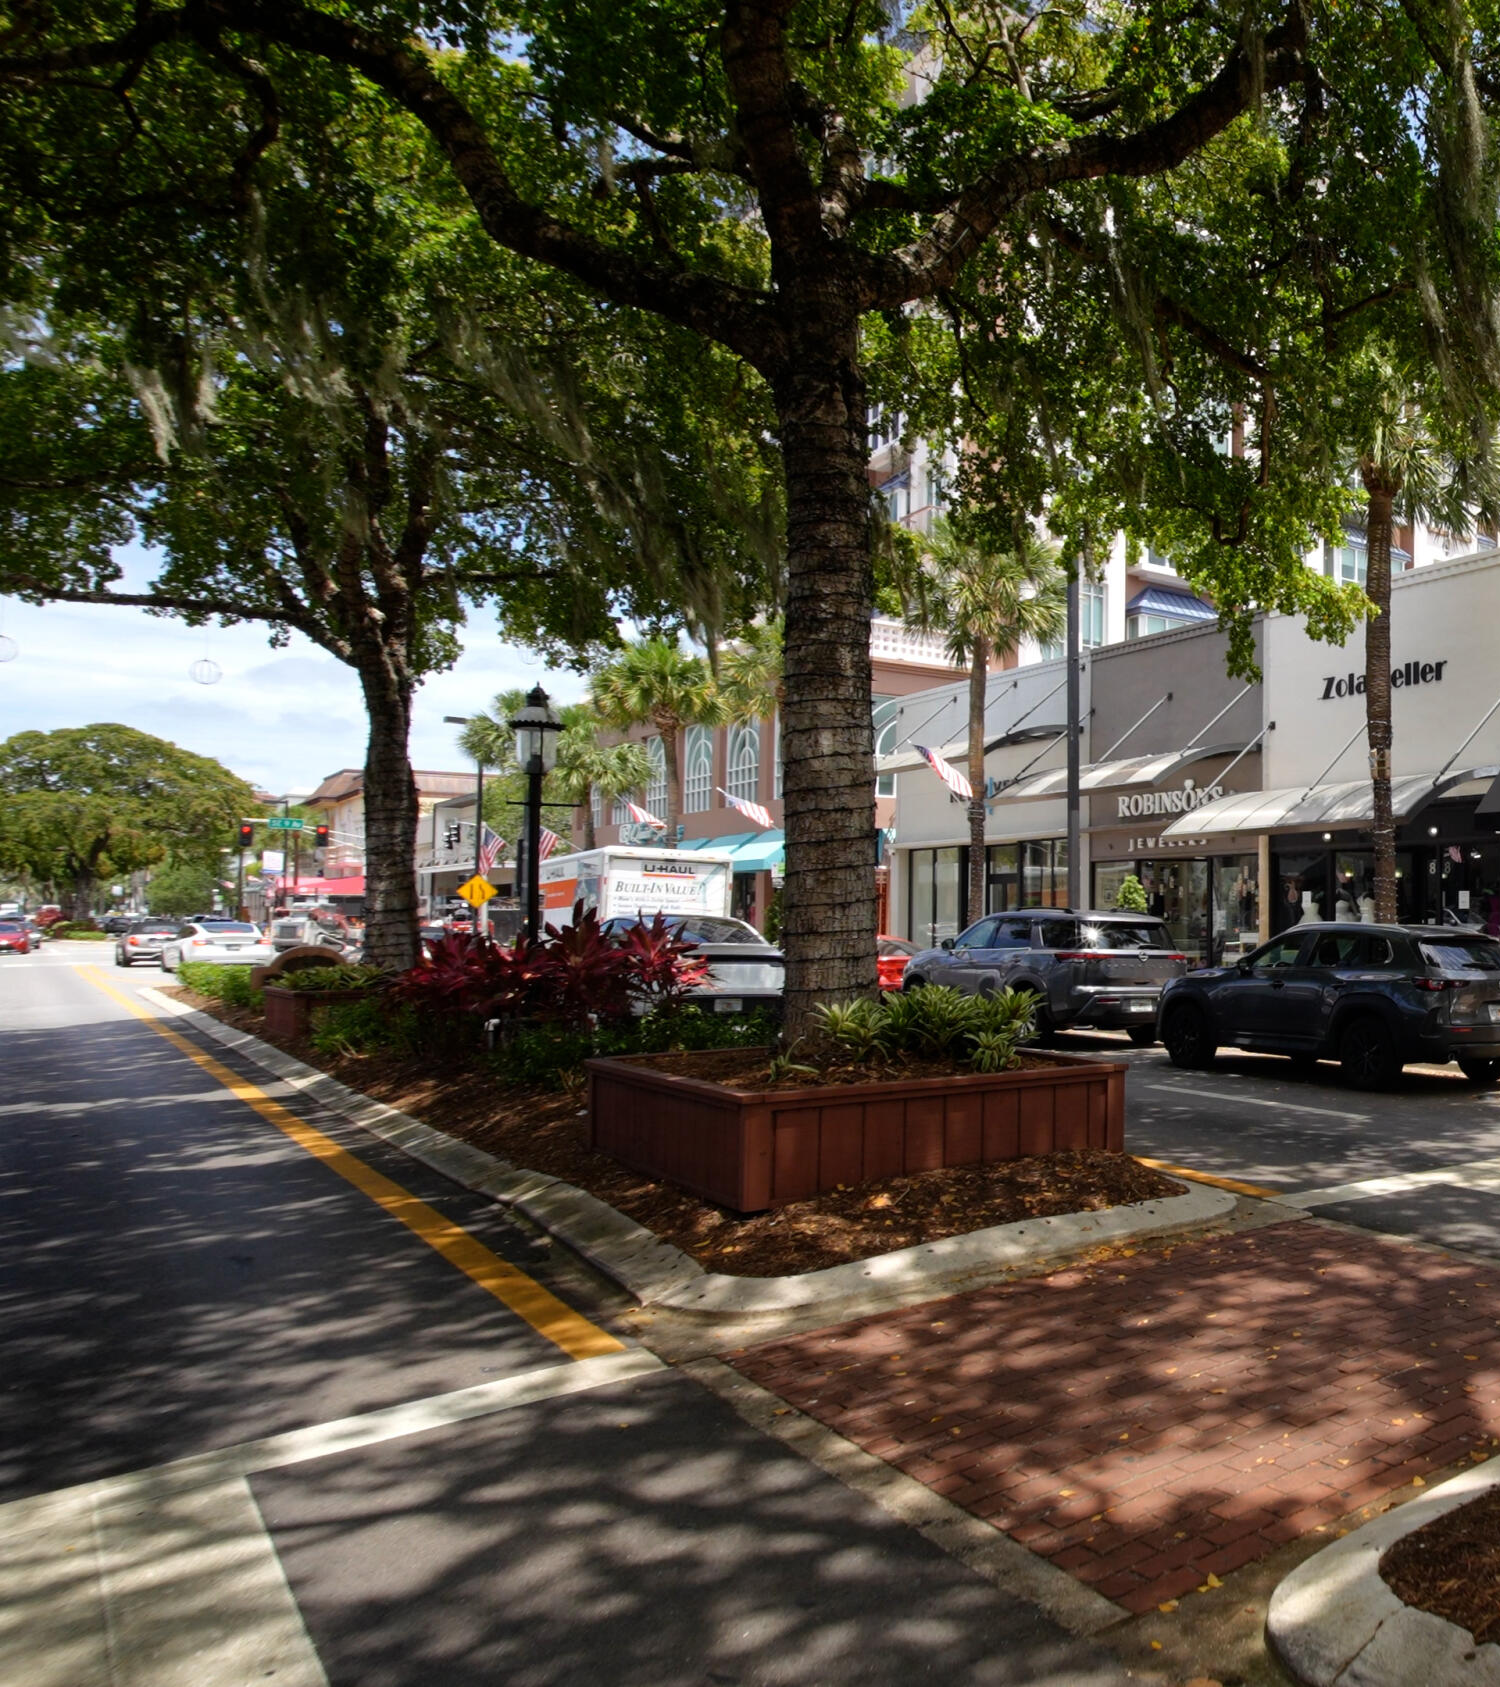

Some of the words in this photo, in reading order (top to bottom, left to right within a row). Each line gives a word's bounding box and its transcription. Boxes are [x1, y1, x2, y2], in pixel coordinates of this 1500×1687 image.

[1318, 672, 1367, 701] Zola
[1390, 660, 1448, 689] eller
[644, 863, 695, 875] U-HAUL
